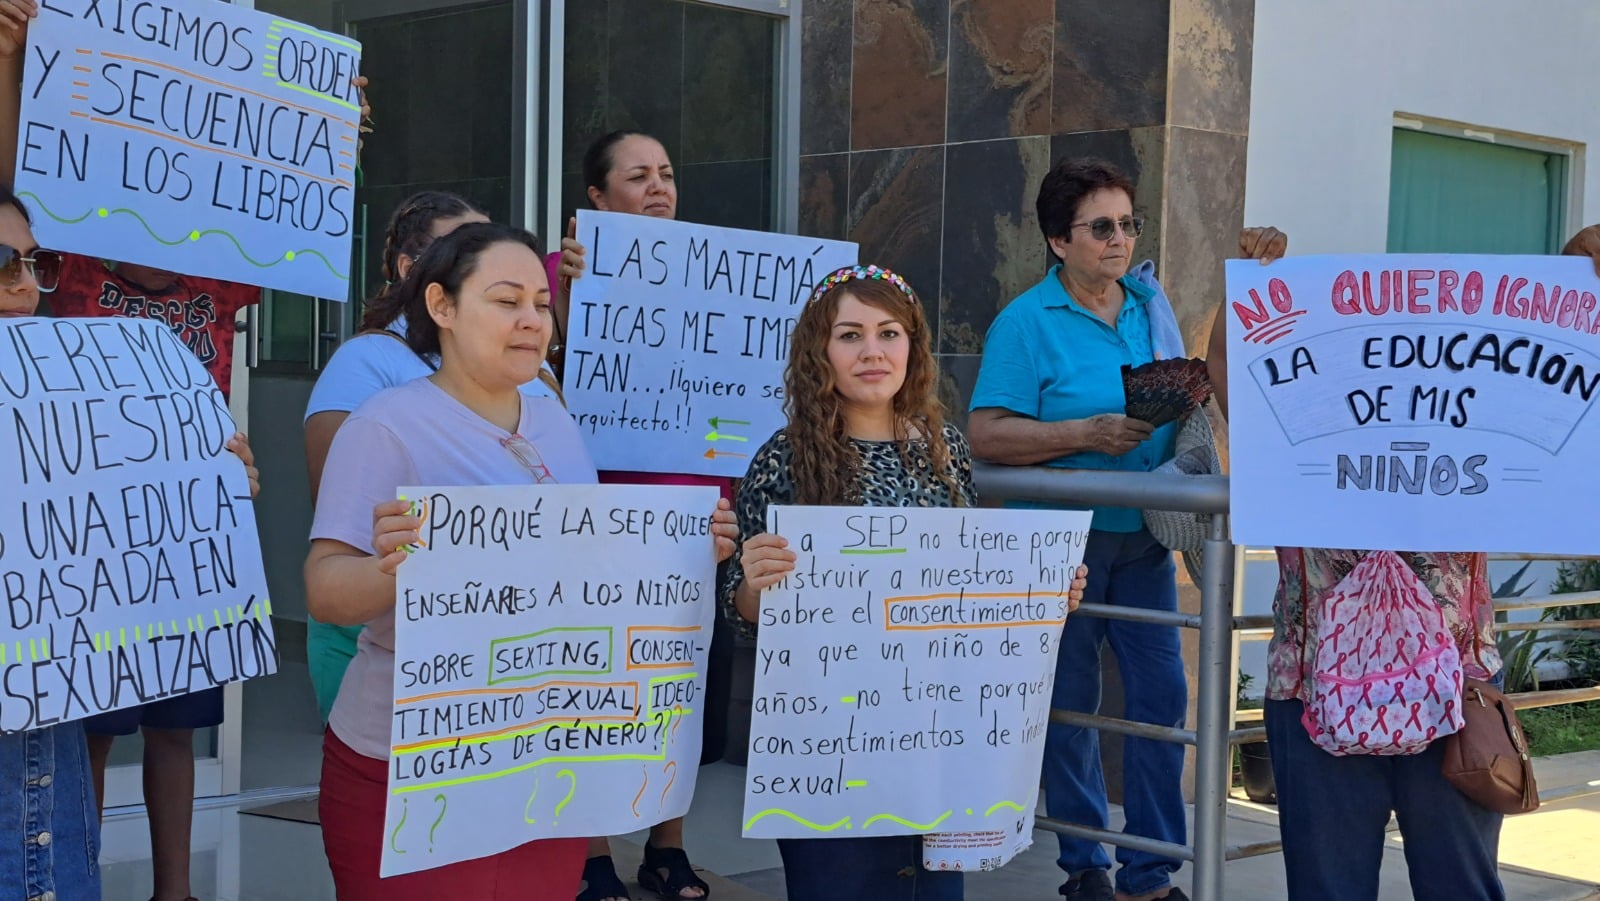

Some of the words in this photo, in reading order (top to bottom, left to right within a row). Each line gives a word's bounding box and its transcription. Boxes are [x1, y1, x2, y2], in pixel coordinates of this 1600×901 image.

[278, 37, 361, 106] ORDEN
[34, 45, 60, 99] Y
[92, 63, 334, 175] SECUENCIA
[22, 122, 89, 181] EN
[122, 141, 192, 201] LOS
[211, 161, 349, 236] LIBROS
[592, 226, 668, 285] LAS
[1232, 278, 1293, 330] NO
[1332, 270, 1483, 315] QUIERO
[581, 302, 666, 347] TICAS
[681, 311, 725, 353] ME
[1264, 347, 1320, 386] LA
[1362, 334, 1600, 402] EDUCACIÓN
[1347, 385, 1393, 425] DE
[1409, 385, 1476, 427] MIS
[1337, 442, 1488, 495] NIÑOS
[22, 491, 115, 560] UNA
[561, 507, 595, 535] LA
[609, 508, 655, 543] SEP
[843, 514, 907, 548] SEP
[920, 532, 941, 550] no
[958, 516, 1020, 551] tiene
[3, 547, 180, 630] BASADA
[189, 534, 237, 597] EN
[548, 581, 563, 606] A
[583, 581, 622, 606] LOS
[636, 574, 700, 607] NIÑOS
[890, 569, 902, 589] a
[921, 551, 1014, 588] nuestros
[763, 593, 834, 627] sobre
[852, 591, 872, 625] el
[890, 584, 1046, 625] consentimiento
[49, 616, 96, 660] LA
[761, 648, 790, 675] ya
[819, 643, 859, 677] que
[881, 640, 904, 662] un
[929, 632, 983, 658] niño
[1000, 627, 1022, 656] de
[401, 653, 475, 688] SOBRE
[755, 691, 829, 715] años,
[902, 667, 964, 702] tiene
[980, 673, 1044, 717] porqué
[395, 693, 524, 740] TIMIENTO
[753, 709, 964, 755] consentimientos
[987, 709, 1011, 748] de
[396, 738, 492, 780] LOGÍAS
[513, 733, 534, 760] DE
